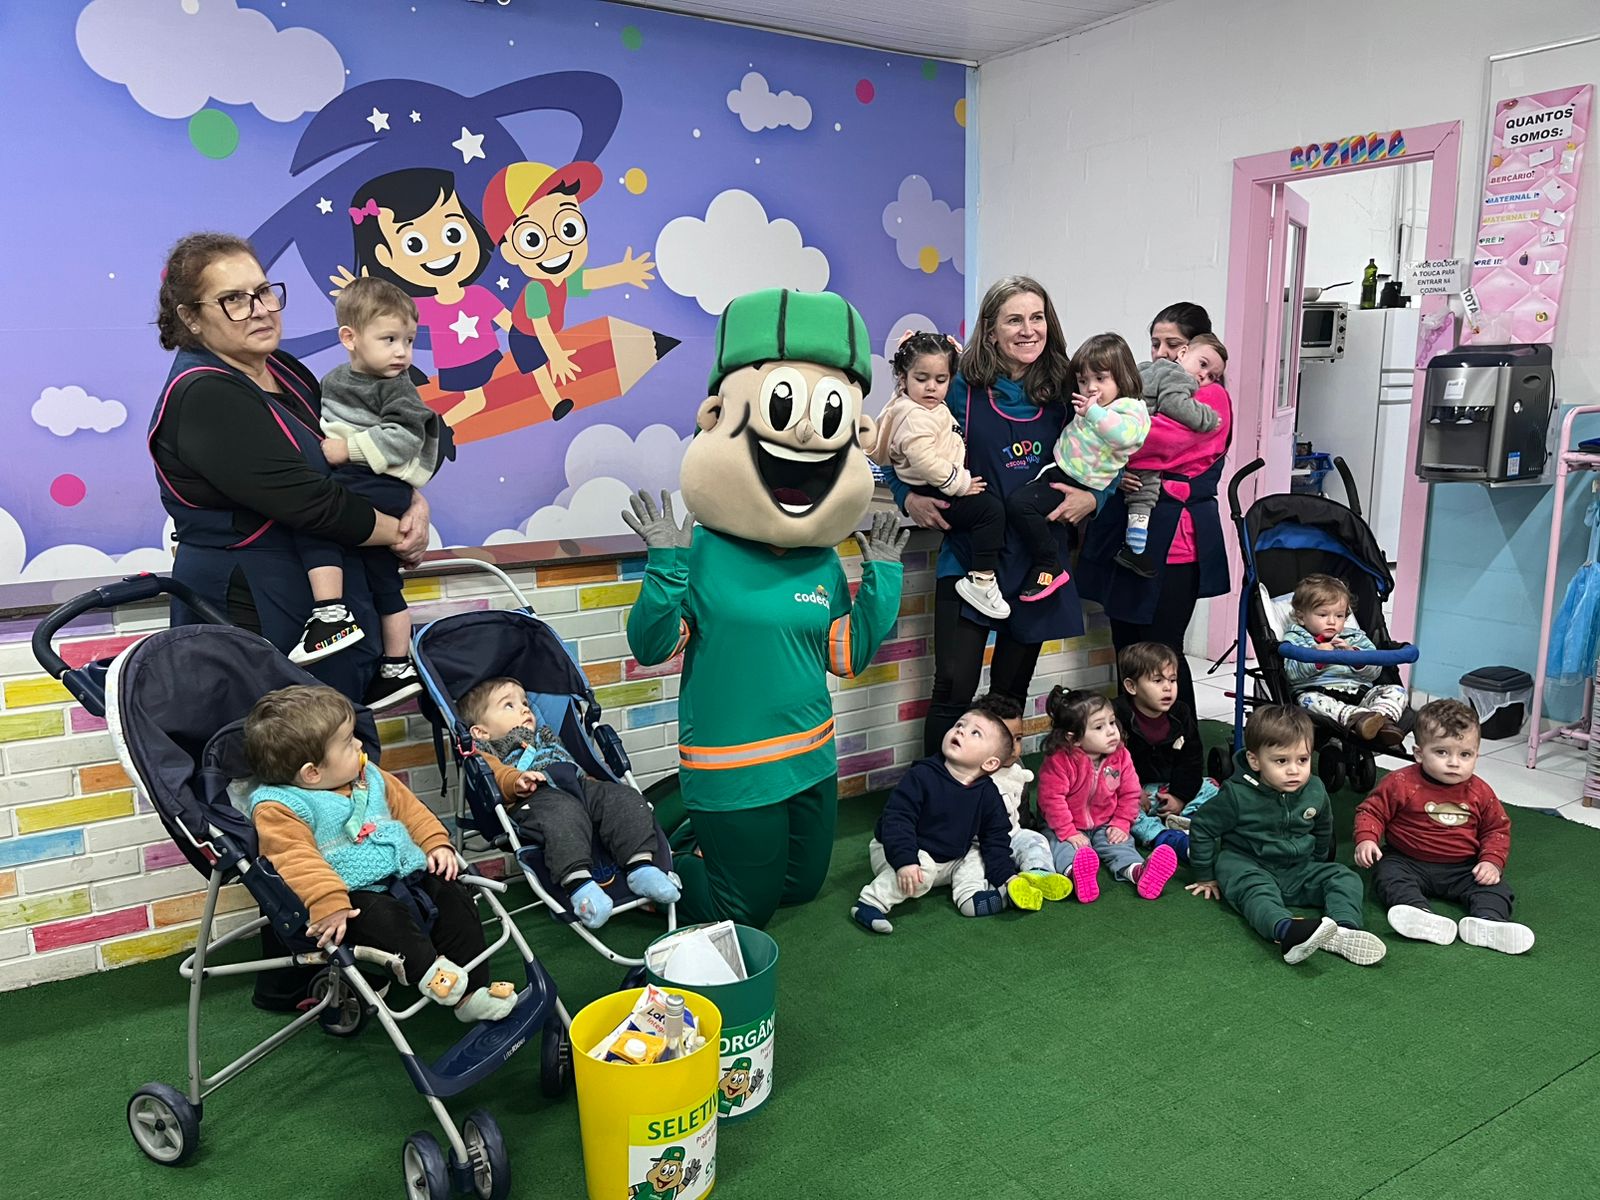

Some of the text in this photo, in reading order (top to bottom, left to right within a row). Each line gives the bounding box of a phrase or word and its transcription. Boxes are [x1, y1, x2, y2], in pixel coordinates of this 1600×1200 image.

[1506, 108, 1573, 129] QUANTOS
[1510, 127, 1564, 145] SOMOS:
[1486, 194, 1531, 203] MATERNAL
[1002, 440, 1042, 459] TOPO
